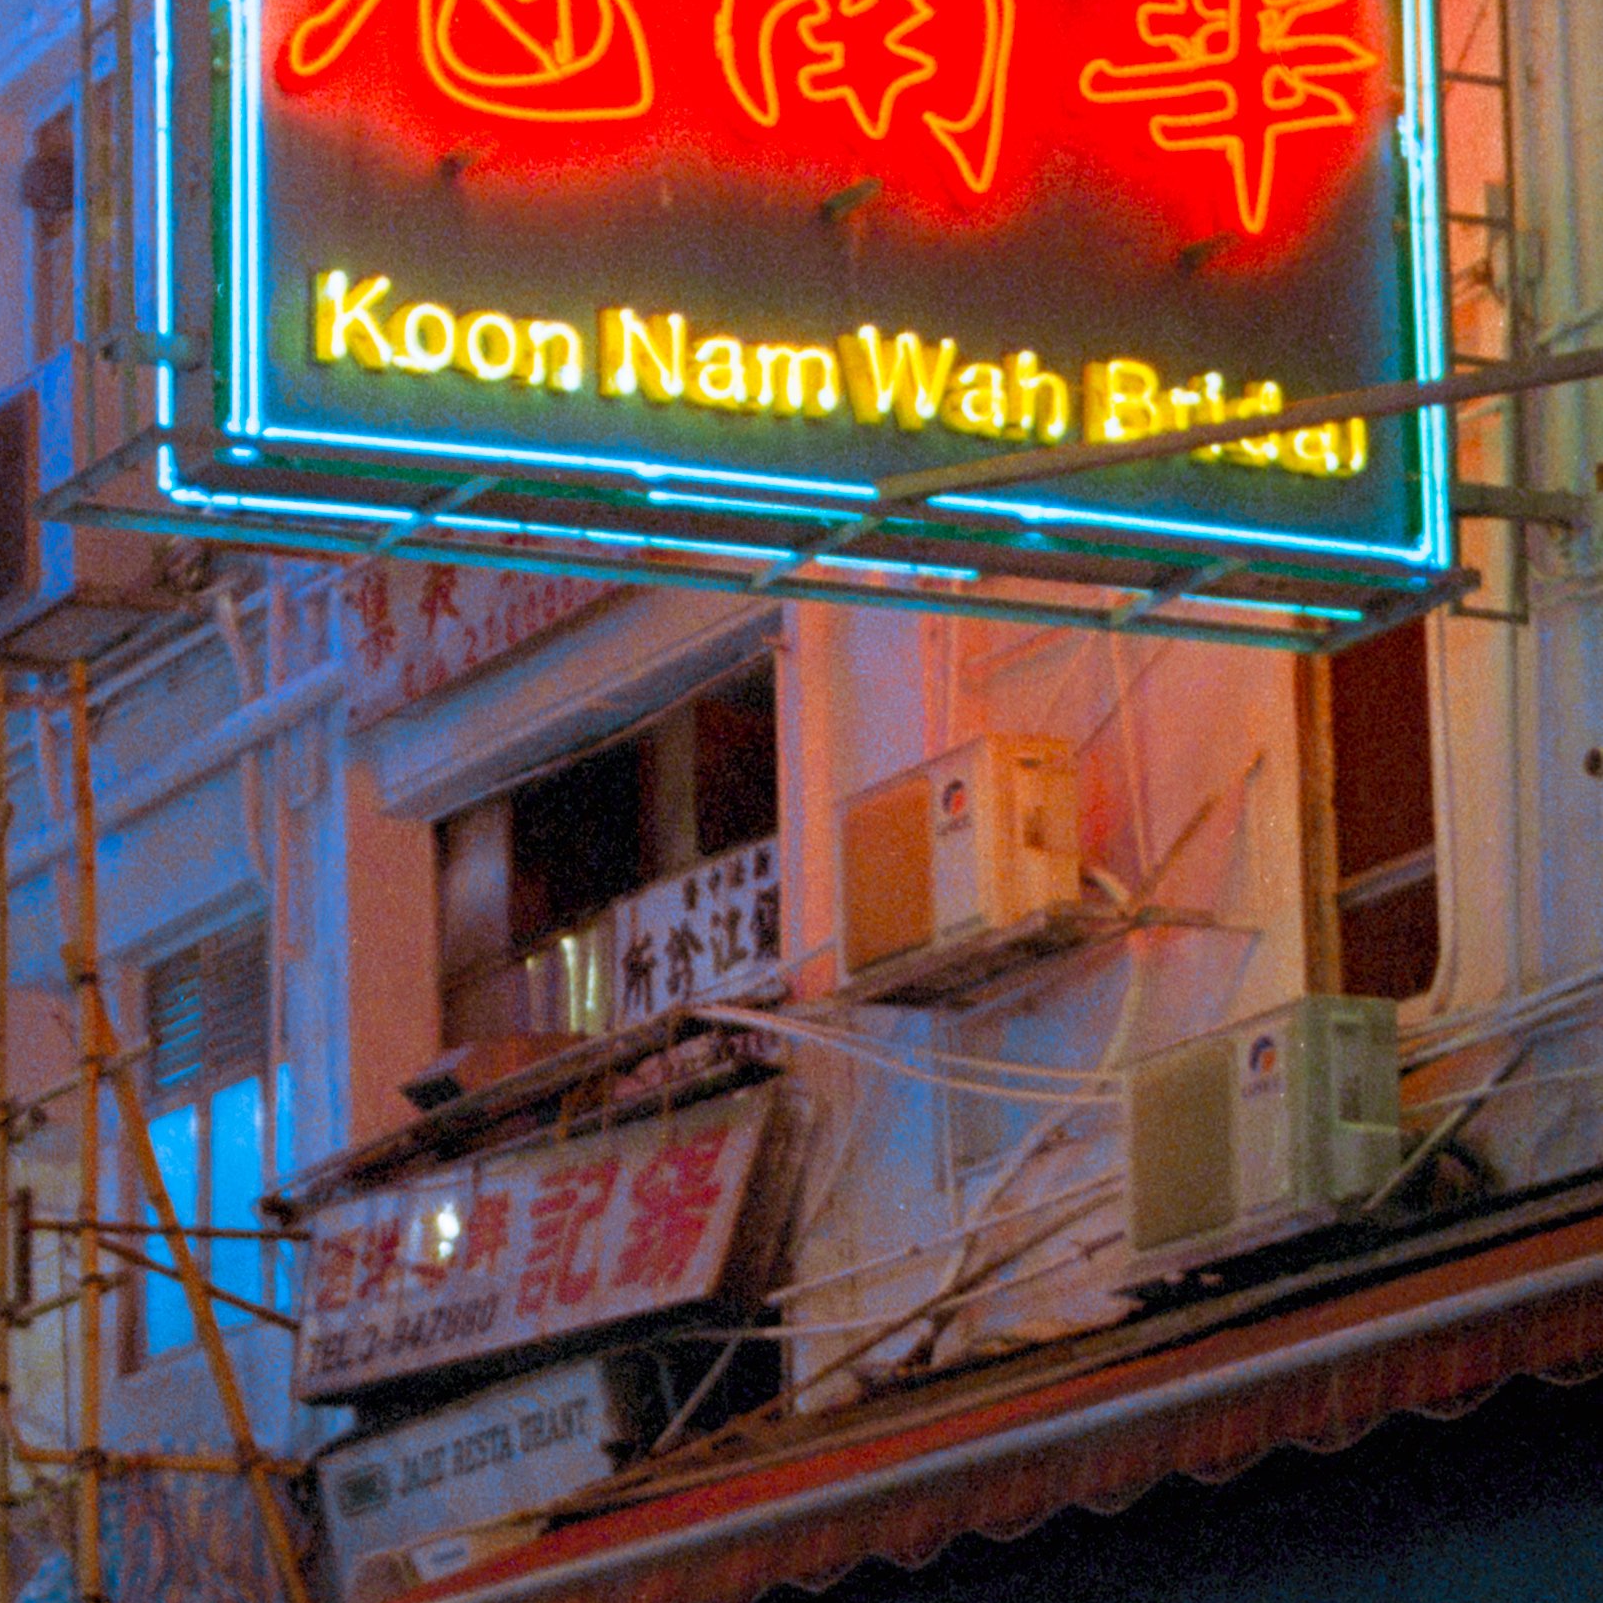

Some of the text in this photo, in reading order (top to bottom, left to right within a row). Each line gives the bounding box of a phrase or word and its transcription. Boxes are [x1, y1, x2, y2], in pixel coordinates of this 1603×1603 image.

[316, 269, 584, 393] Koon
[600, 307, 838, 415] Nam
[839, 325, 1071, 443] Wah
